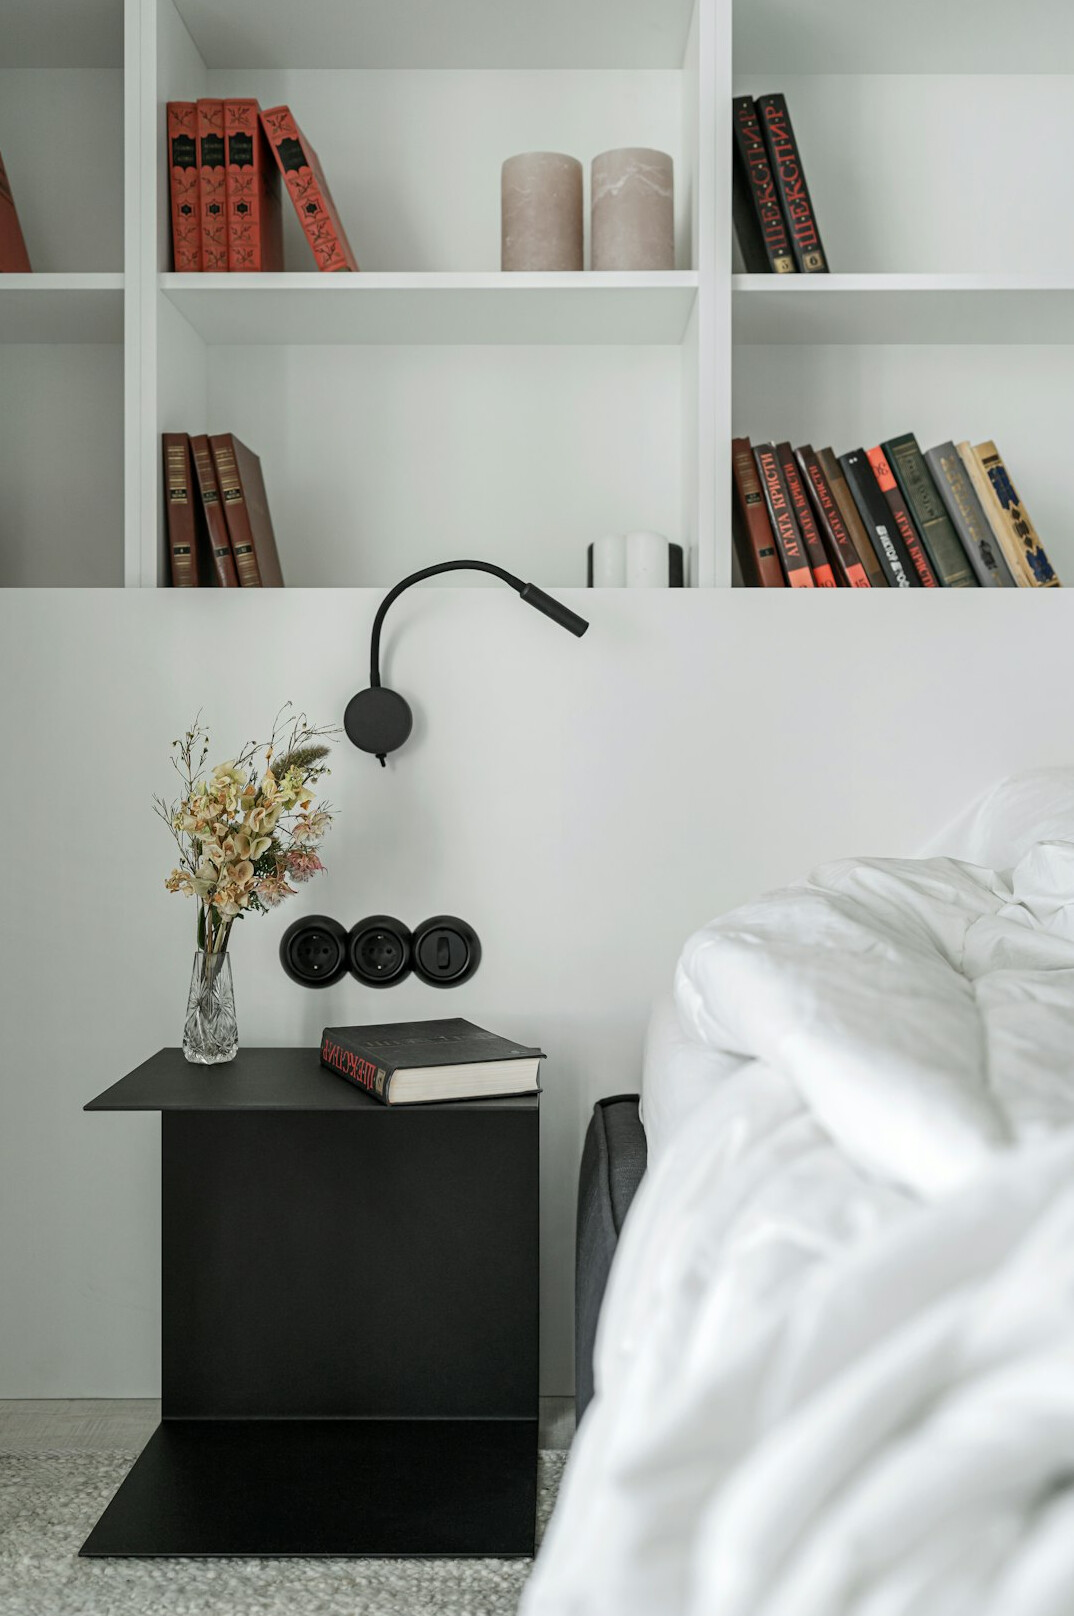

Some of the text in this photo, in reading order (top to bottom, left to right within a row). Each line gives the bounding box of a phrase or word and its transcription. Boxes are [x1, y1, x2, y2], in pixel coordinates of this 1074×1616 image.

[760, 452, 800, 557] АГАТА КРИСТИ
[783, 463, 818, 545] АГАТА КРИСТИ
[809, 465, 848, 545] АГАТА КРИСТИ
[894, 511, 915, 545] АГАТА
